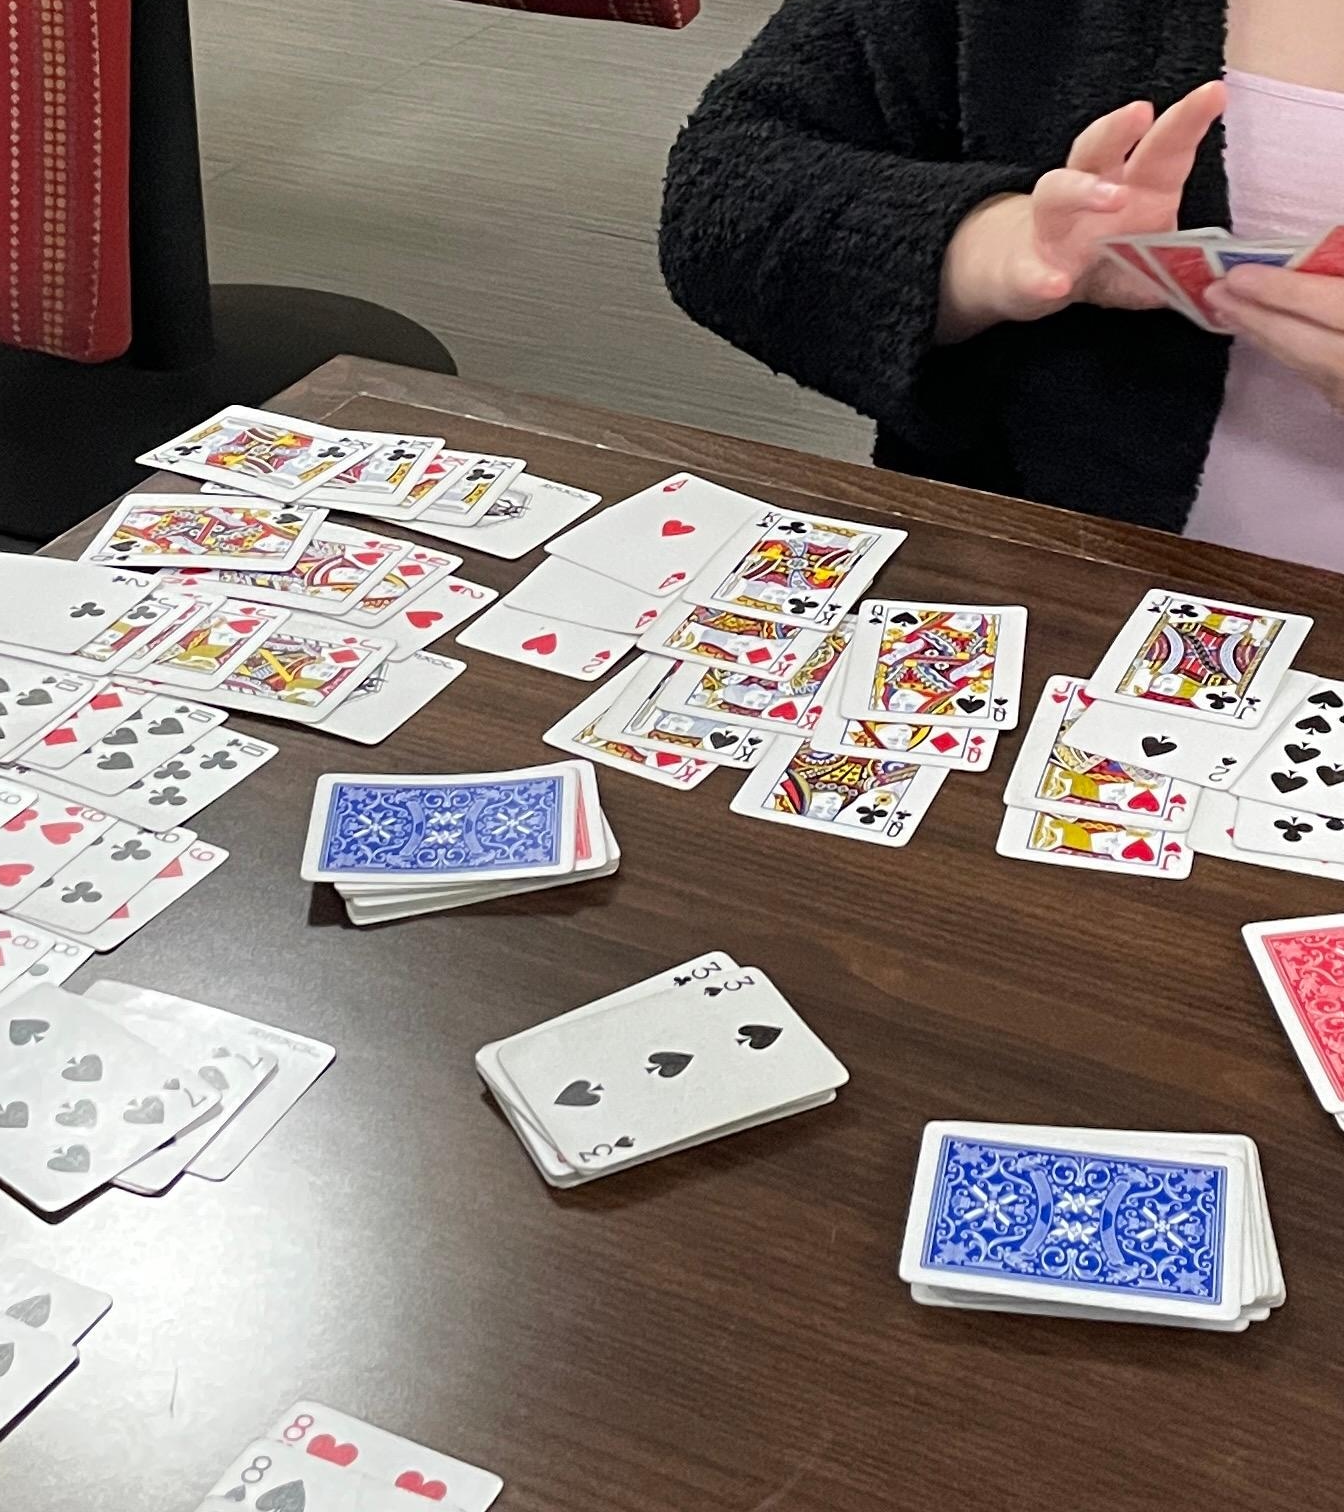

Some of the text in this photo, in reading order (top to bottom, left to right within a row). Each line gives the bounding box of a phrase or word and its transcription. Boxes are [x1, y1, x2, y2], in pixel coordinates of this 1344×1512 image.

[762, 511, 781, 523] K
[871, 604, 884, 616] Q
[815, 611, 837, 626] K
[582, 658, 604, 673] 2
[768, 661, 792, 676] K
[1055, 681, 1073, 694] J
[188, 709, 216, 723] 10
[993, 707, 1007, 722] Q
[1236, 706, 1257, 720] J
[240, 742, 268, 757] 10
[733, 746, 757, 762] K
[967, 747, 982, 763] Q
[674, 765, 701, 782] K
[1209, 766, 1230, 782] 2
[1163, 806, 1185, 822] J
[886, 821, 904, 837] Q
[1159, 854, 1181, 870] J
[12, 934, 39, 949] 8
[53, 942, 79, 957] 8
[691, 962, 722, 979] 3
[724, 975, 755, 992] 3
[578, 1143, 612, 1162] 3
[283, 1414, 315, 1442] 8
[240, 1455, 272, 1484] 8
